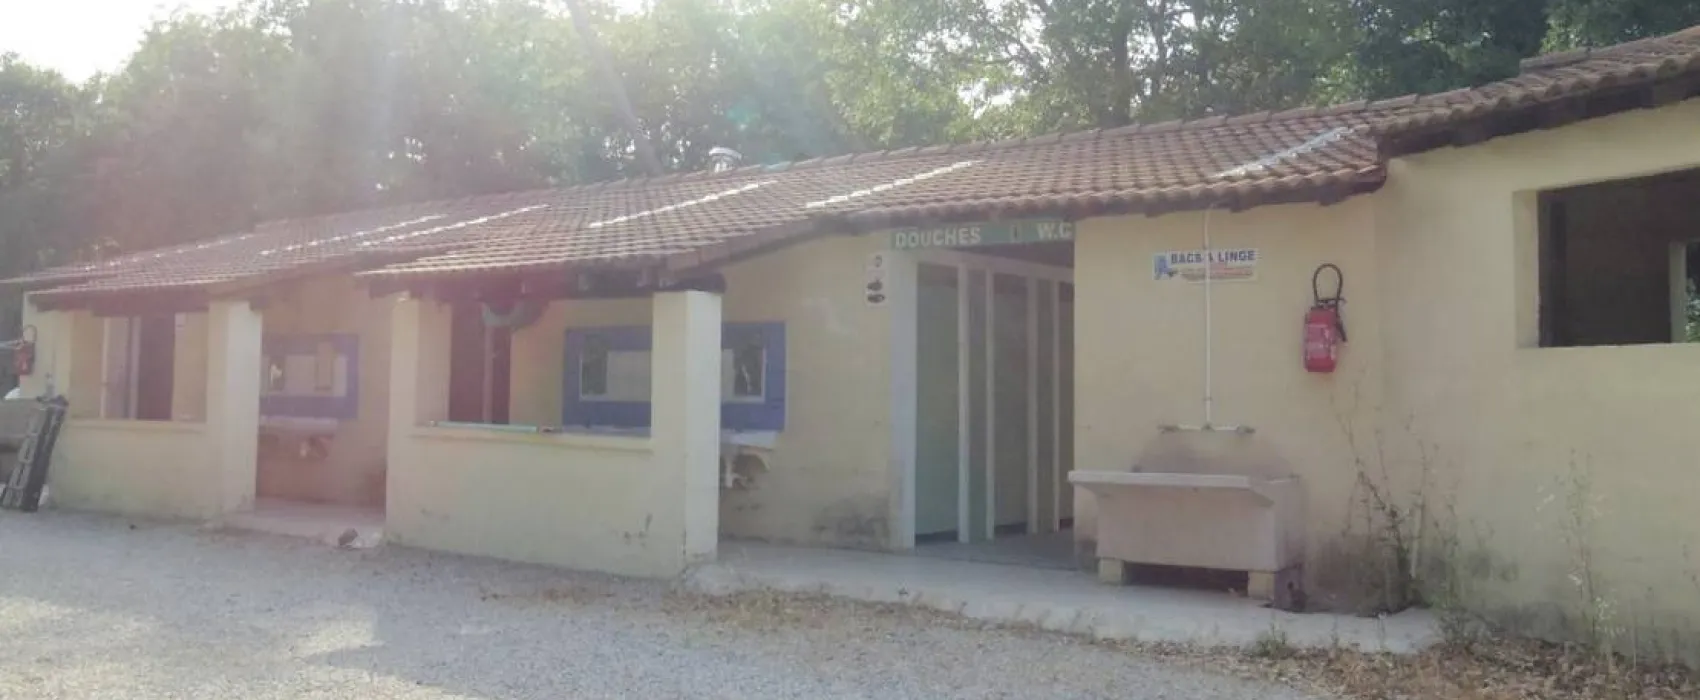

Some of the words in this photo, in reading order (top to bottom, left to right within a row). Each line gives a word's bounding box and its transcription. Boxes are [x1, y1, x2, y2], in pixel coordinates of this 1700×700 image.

[895, 226, 982, 248] DOUCHES
[1171, 252, 1202, 264] BACS
[1218, 250, 1256, 263] LINGE
